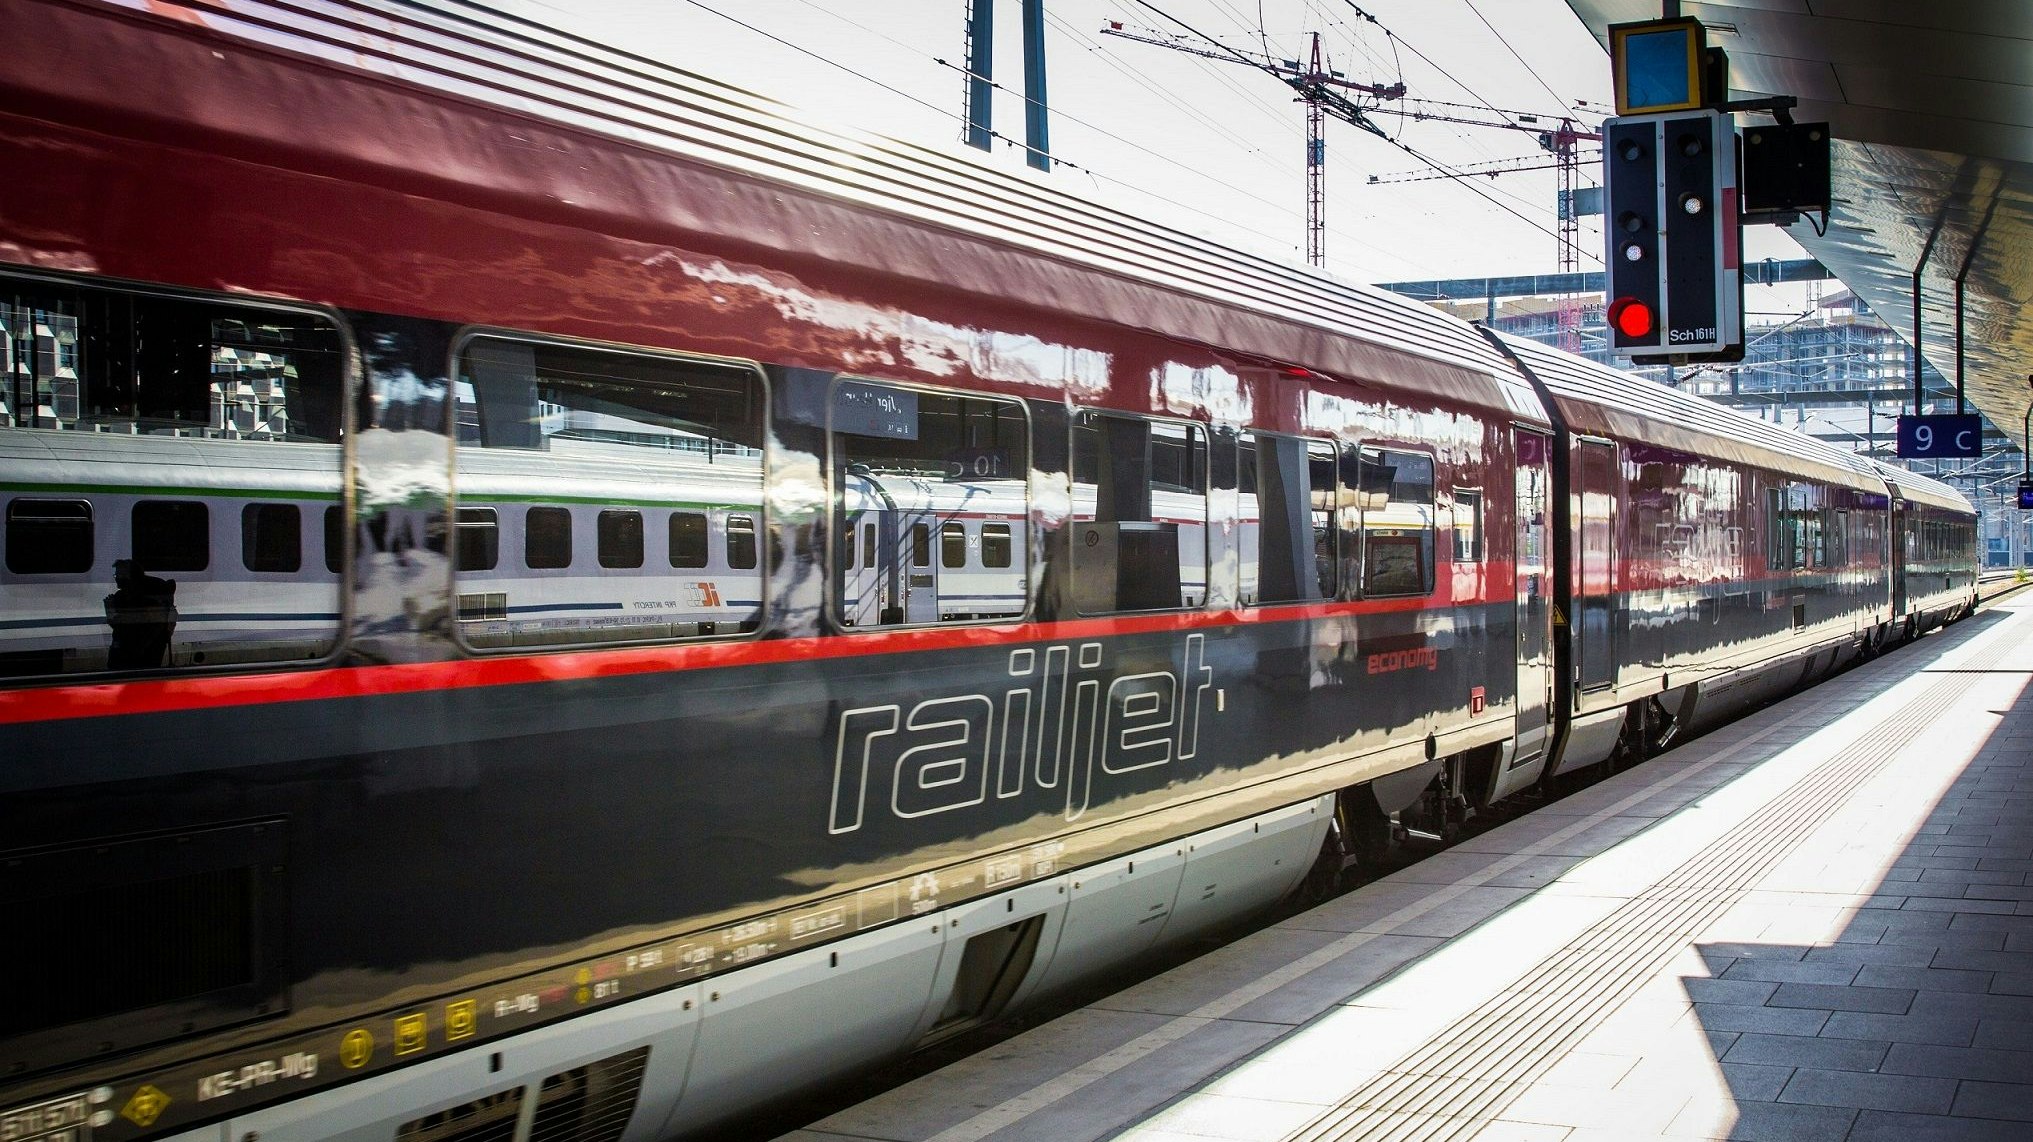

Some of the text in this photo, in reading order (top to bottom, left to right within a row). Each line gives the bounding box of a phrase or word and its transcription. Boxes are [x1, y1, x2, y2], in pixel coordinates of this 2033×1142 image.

[1915, 425, 1933, 451] 9
[1367, 646, 1438, 675] economy
[828, 633, 1213, 835] railjet
